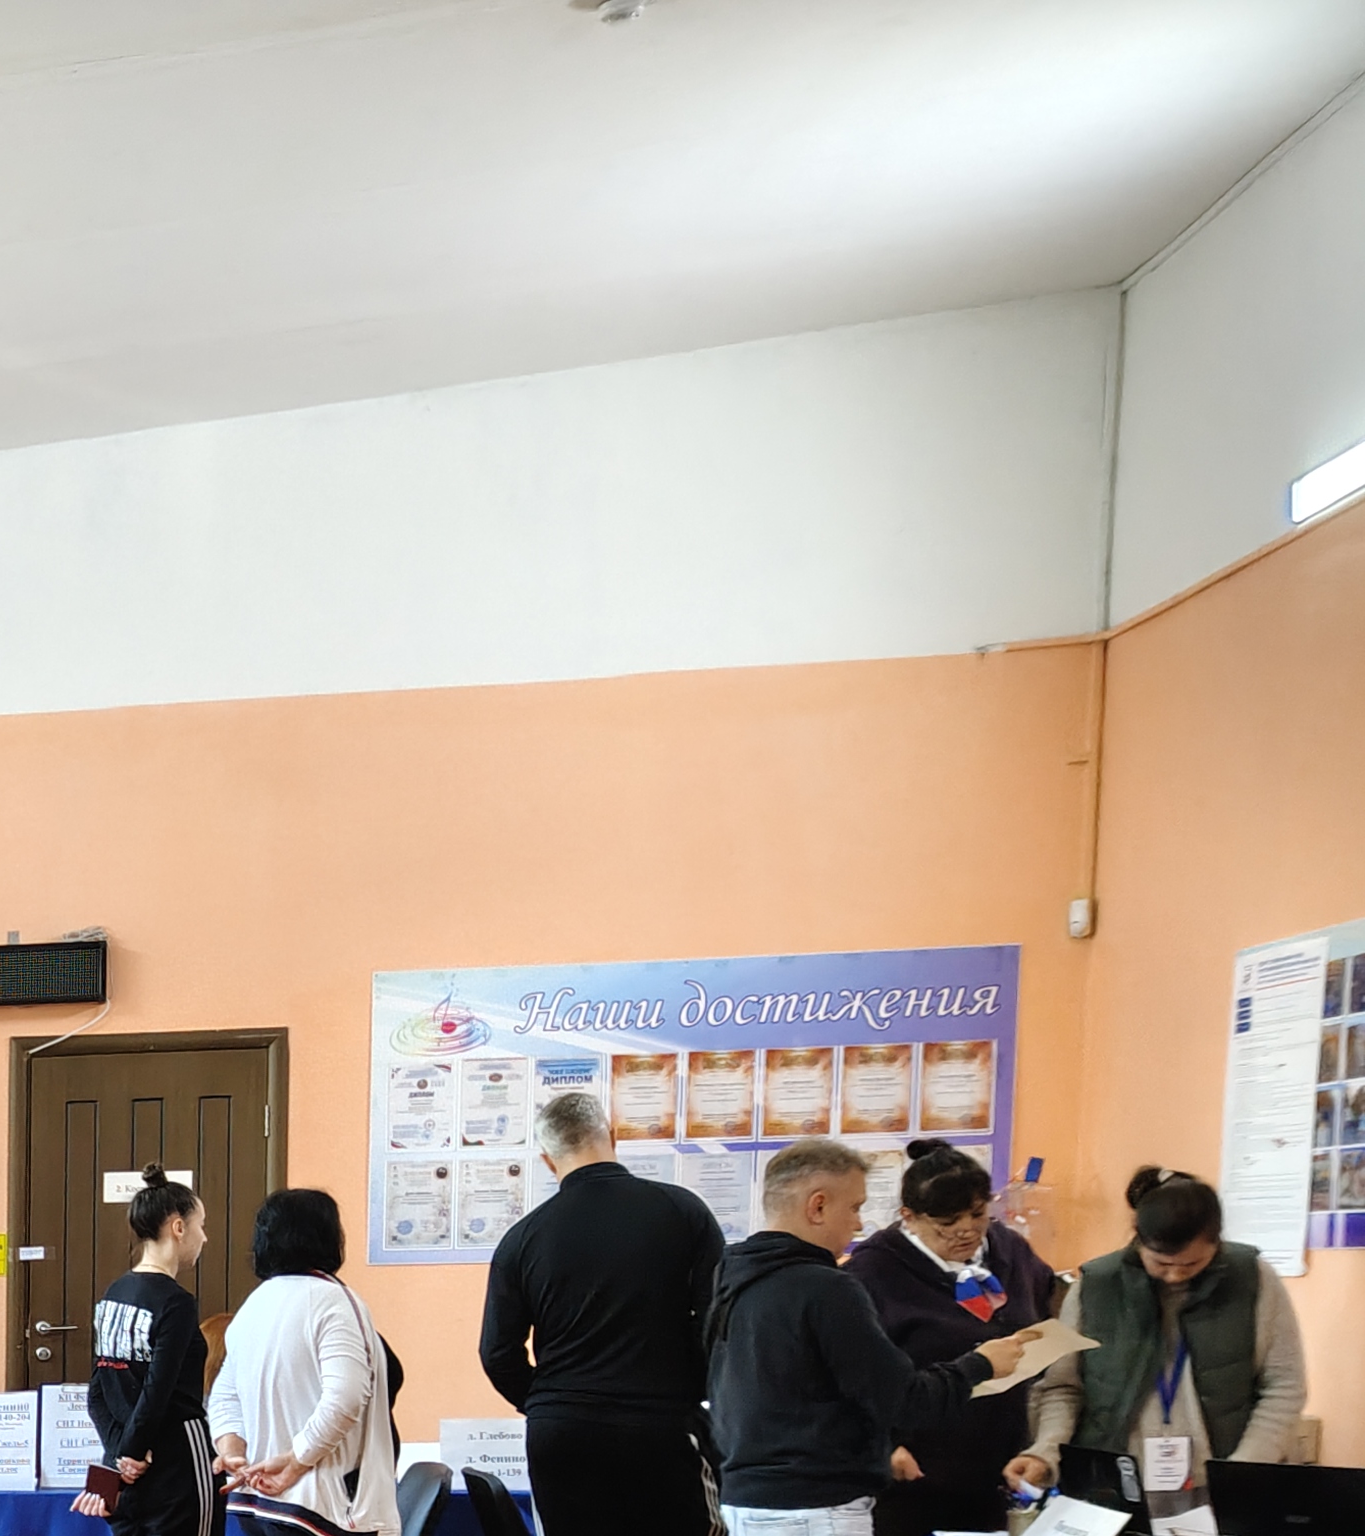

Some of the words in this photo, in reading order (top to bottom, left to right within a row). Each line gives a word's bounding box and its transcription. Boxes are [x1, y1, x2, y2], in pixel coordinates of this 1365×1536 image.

[513, 988, 665, 1034] Наши
[677, 980, 1001, 1032] достижения
[542, 1075, 593, 1086] ДИПЛОМ
[479, 1431, 523, 1441] Глебово
[479, 1454, 527, 1464] Фенино
